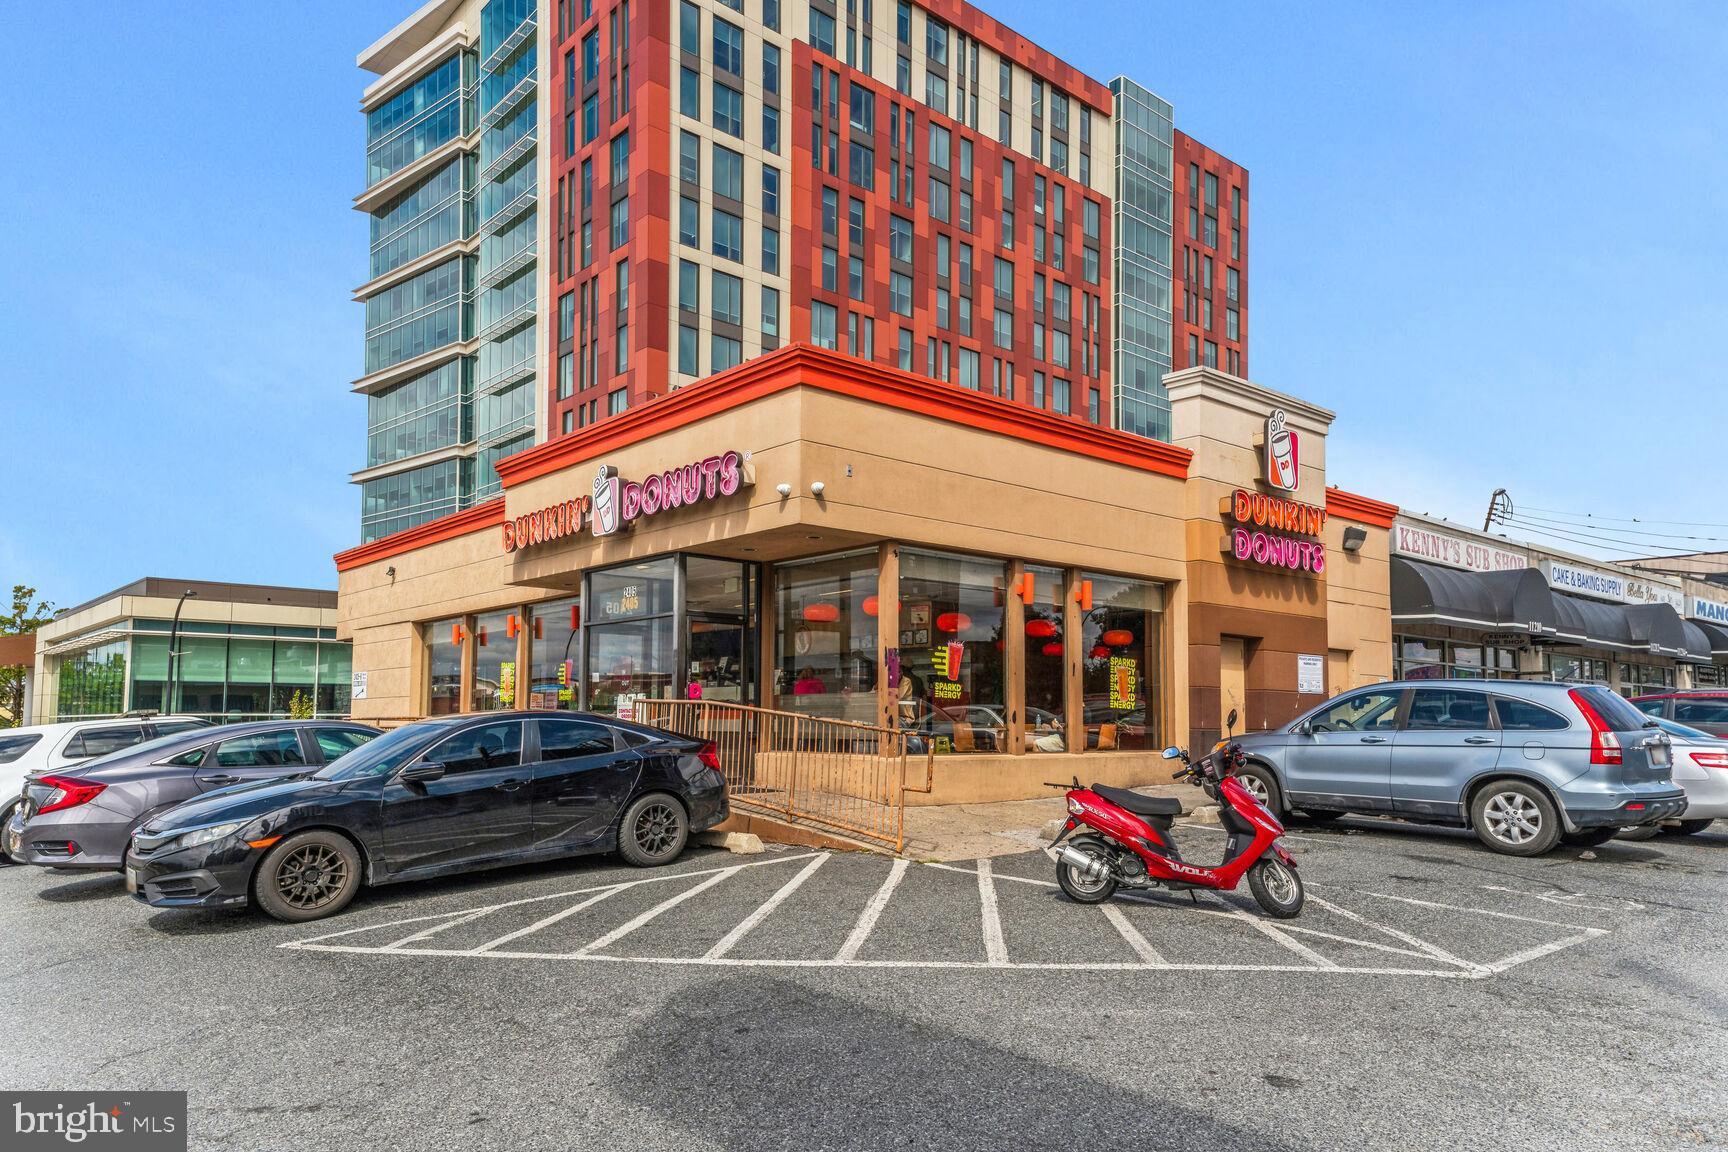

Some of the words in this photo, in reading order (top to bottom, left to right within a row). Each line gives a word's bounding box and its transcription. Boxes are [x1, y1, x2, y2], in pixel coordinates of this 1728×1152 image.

[502, 494, 590, 553] DUNKIN'
[622, 450, 744, 520] DONUTS
[1232, 488, 1328, 538] DUNKIN'
[1232, 527, 1325, 574] DONUTS
[1399, 526, 1462, 564] KENNY'S
[1465, 544, 1490, 571] SUB
[1494, 551, 1525, 571] SHOP
[1552, 566, 1570, 585] CAKE
[1570, 571, 1577, 587] &
[1577, 572, 1600, 591] BAKING
[1600, 577, 1622, 596] SUPPLY
[1110, 656, 1136, 668] SPARKD
[934, 682, 962, 692] SPARKD
[934, 690, 962, 699] ENERGY
[1110, 700, 1136, 710] ENERGY
[1164, 859, 1213, 877] WOLF
